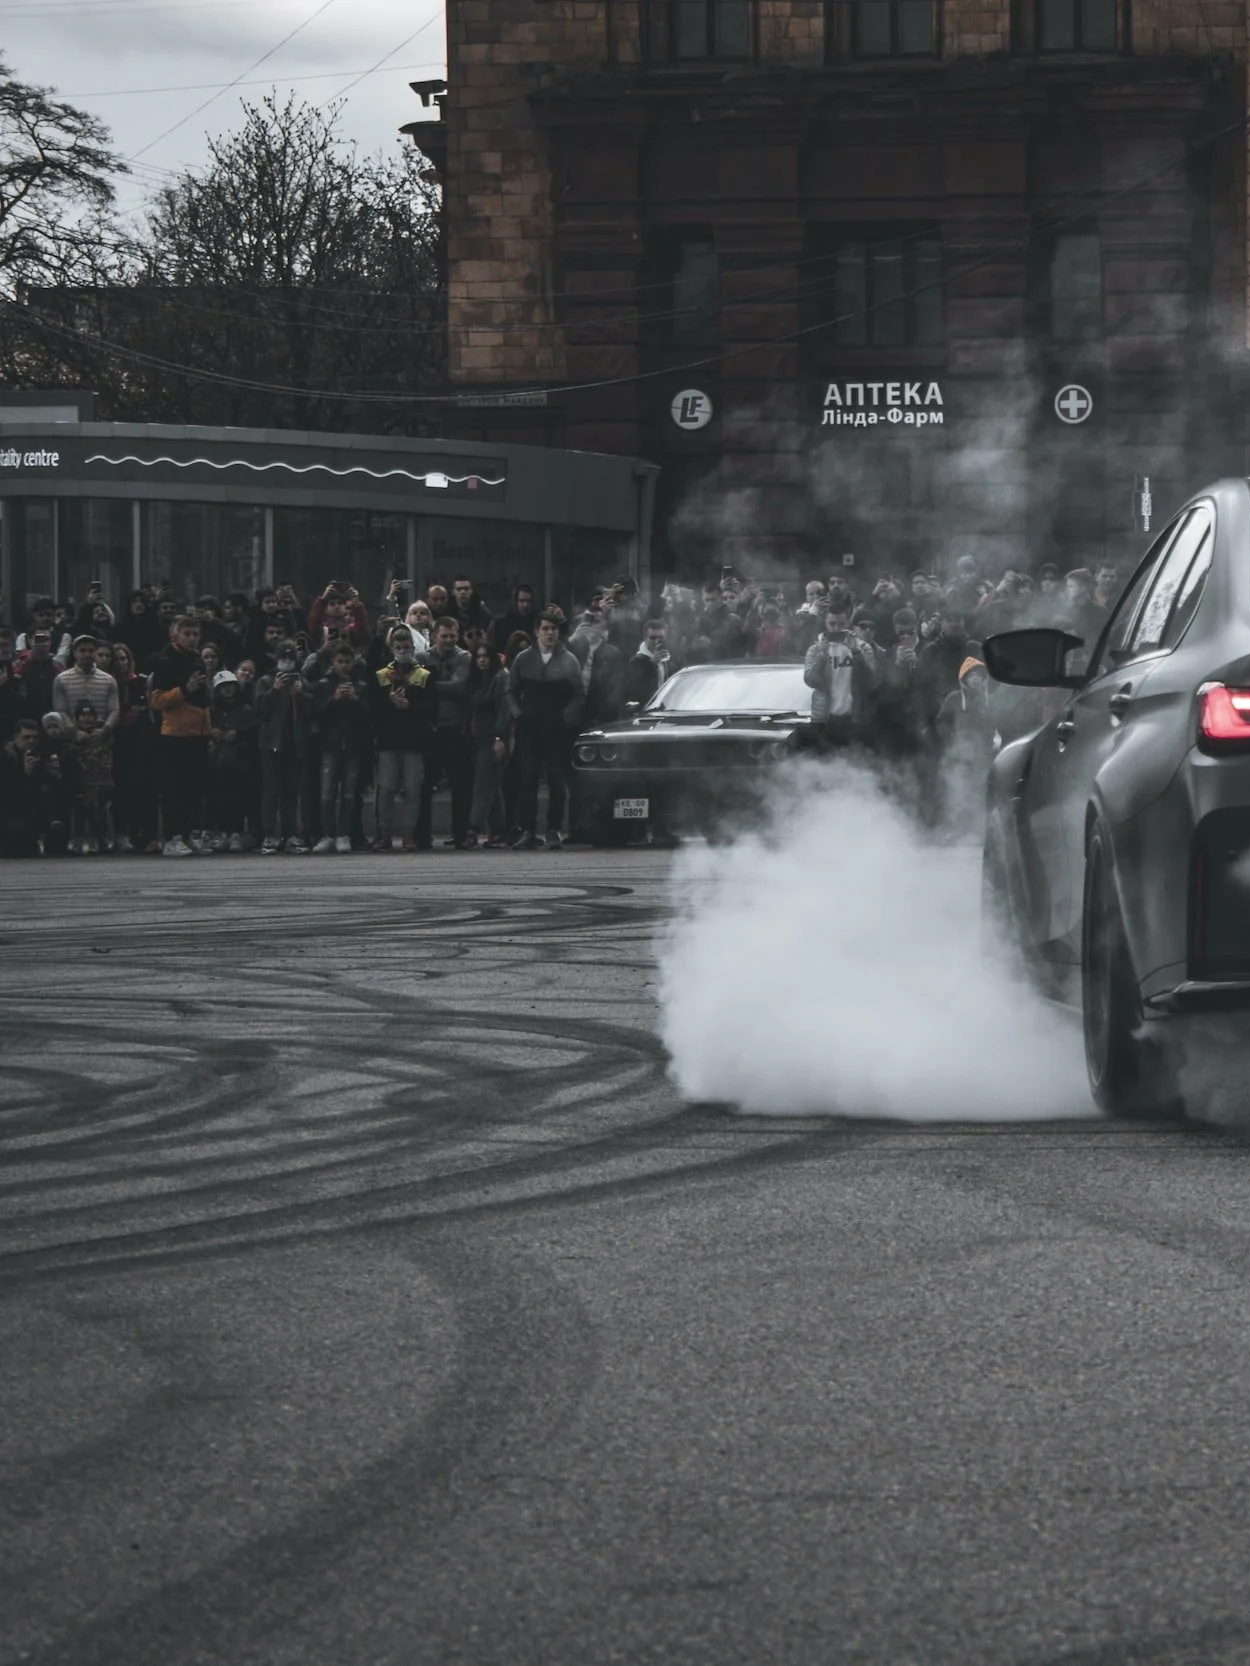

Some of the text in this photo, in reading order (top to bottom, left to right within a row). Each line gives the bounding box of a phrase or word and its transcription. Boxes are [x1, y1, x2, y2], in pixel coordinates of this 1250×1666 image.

[823, 382, 944, 406] АПТЕКА
[821, 407, 944, 428] Лінда-Фарм
[23, 448, 60, 467] centre
